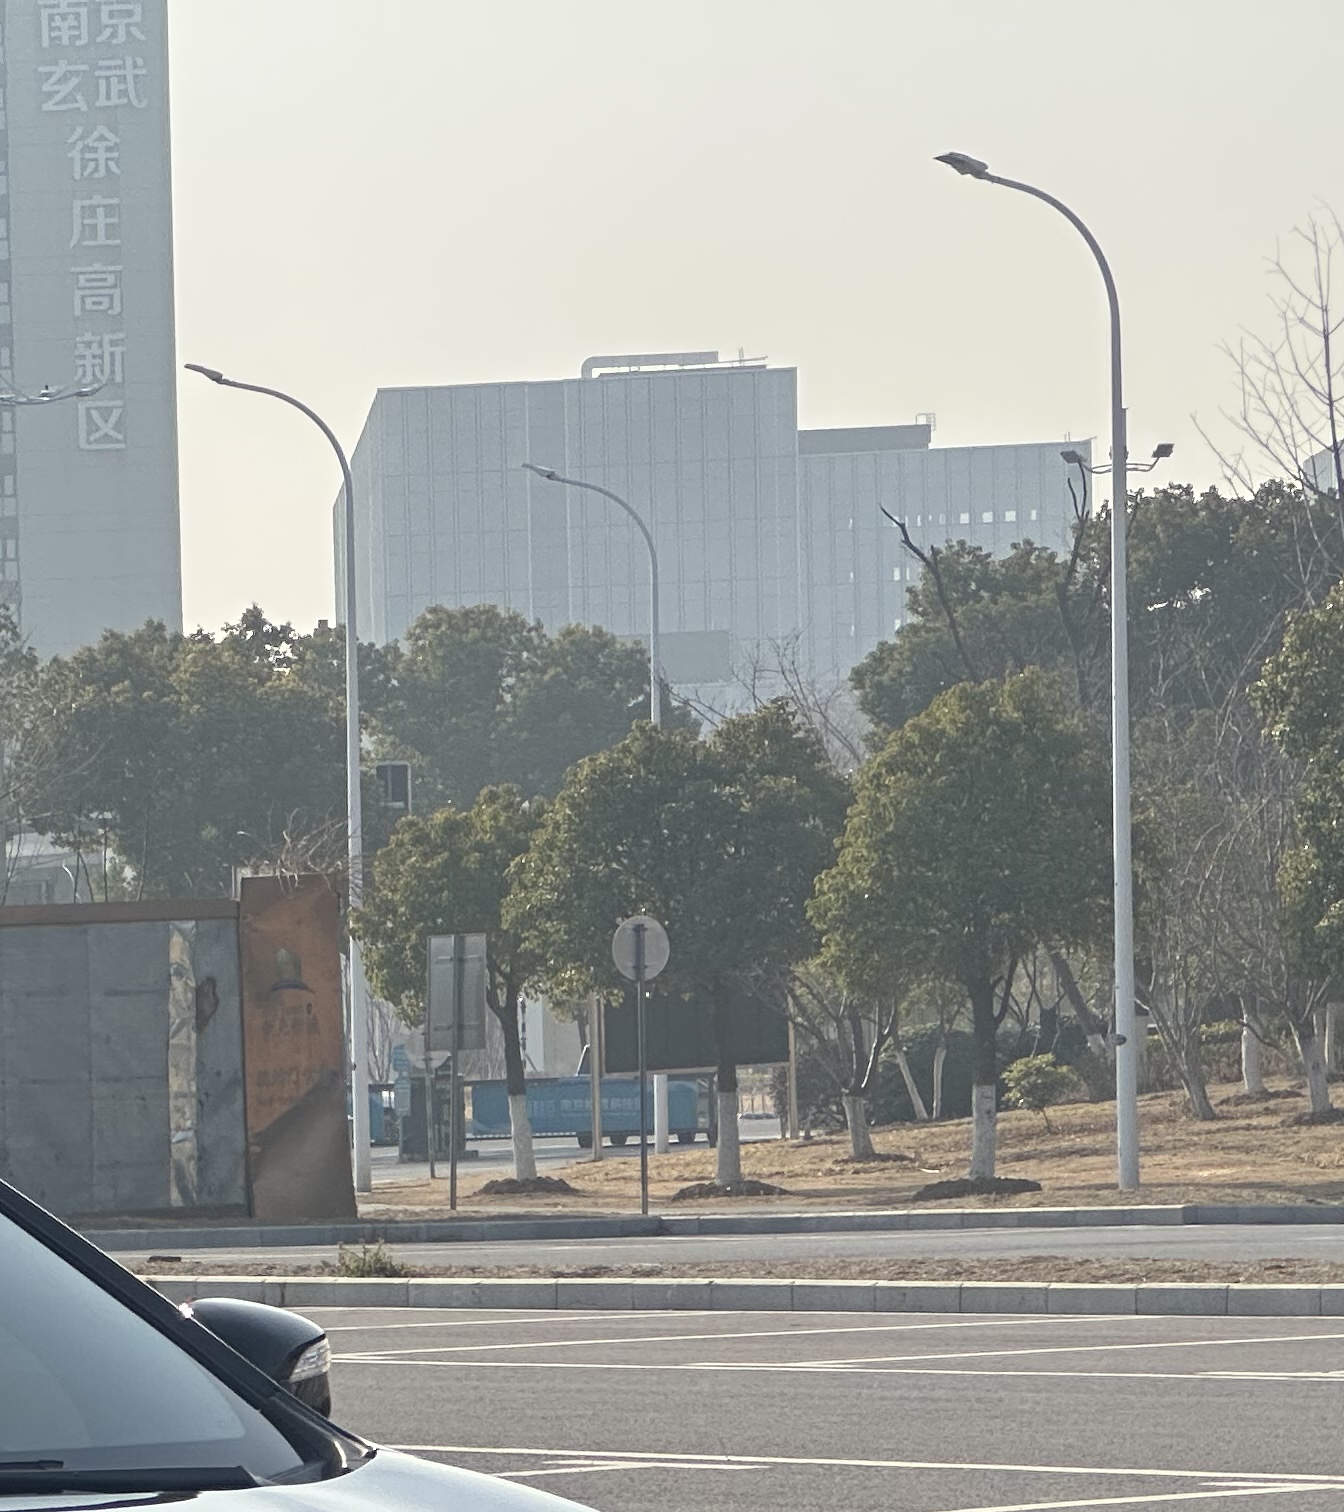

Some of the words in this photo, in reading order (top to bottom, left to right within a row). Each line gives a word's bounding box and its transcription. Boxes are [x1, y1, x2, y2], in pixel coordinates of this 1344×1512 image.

[39, 0, 147, 48] 南京
[37, 56, 148, 113] 玄武
[66, 124, 128, 451] 徐庄高新区
